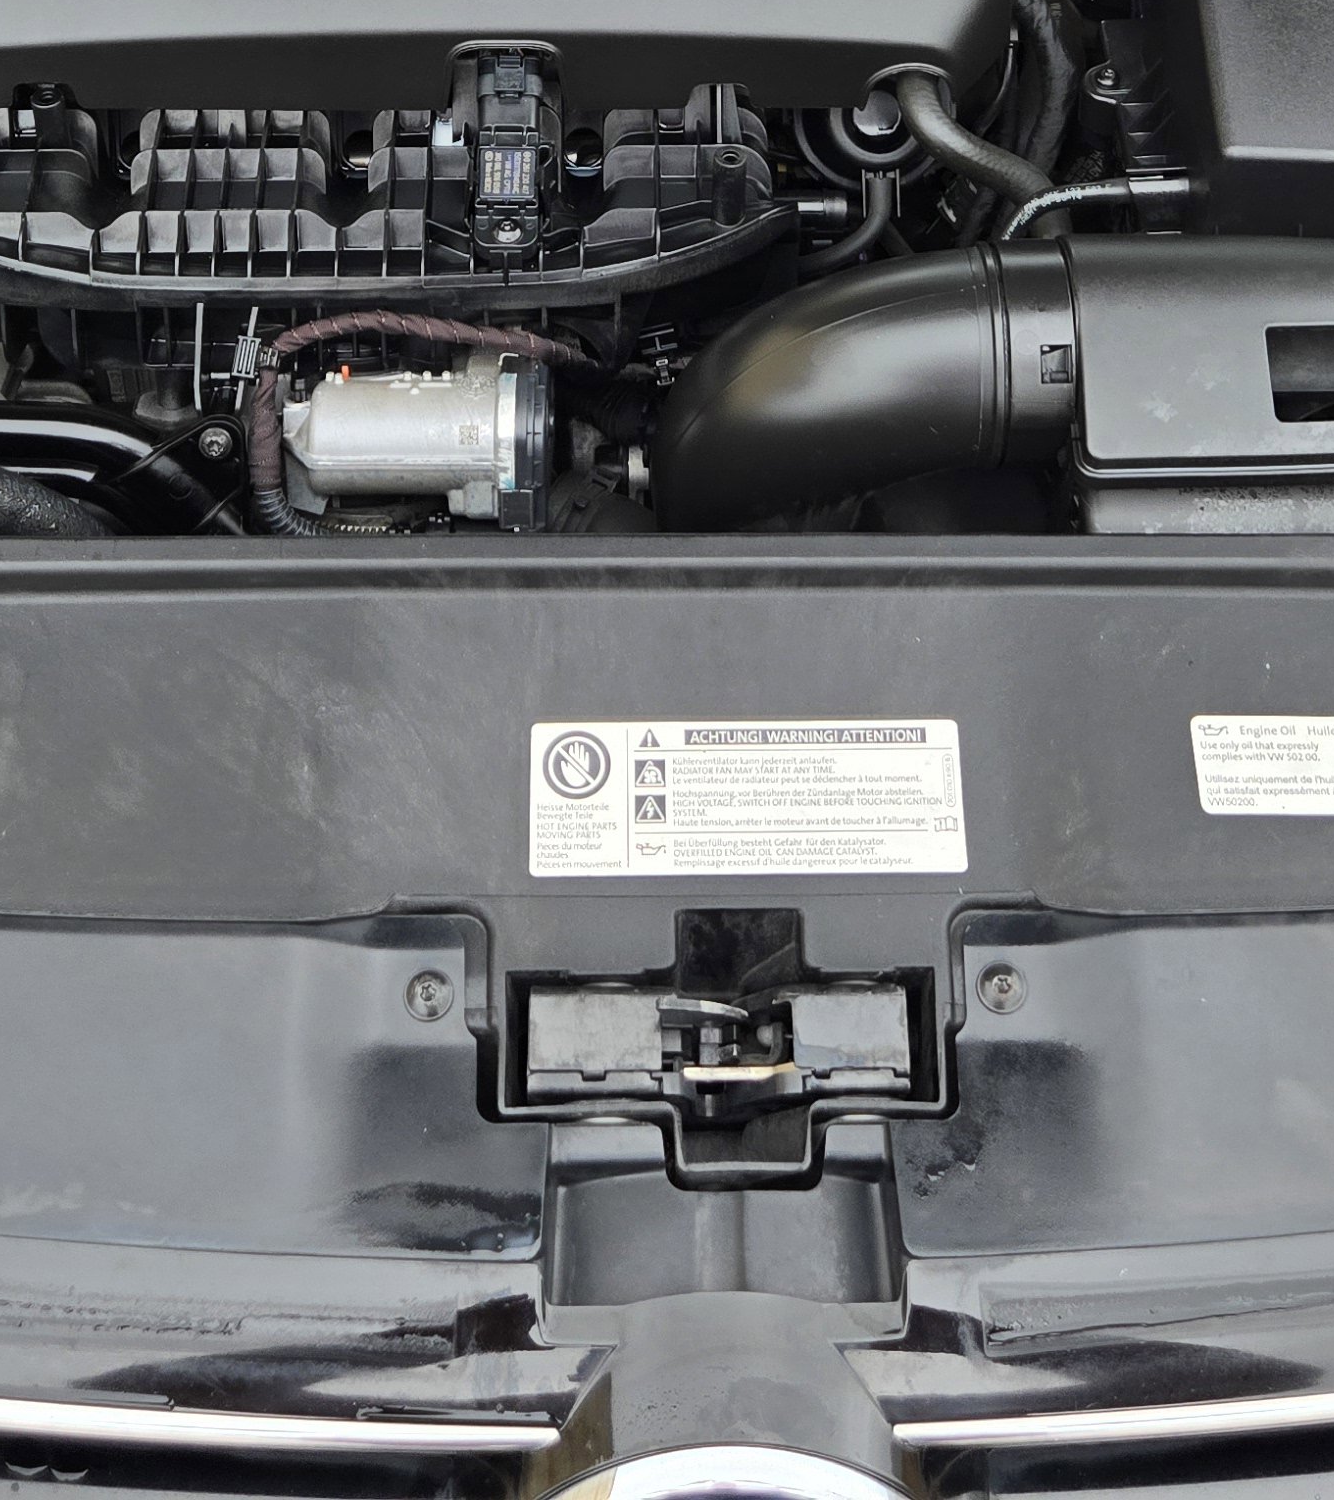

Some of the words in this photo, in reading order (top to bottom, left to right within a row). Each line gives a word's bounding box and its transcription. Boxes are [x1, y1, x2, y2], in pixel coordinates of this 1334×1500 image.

[1239, 726, 1277, 738] Engine
[1280, 726, 1296, 735] Oil
[1200, 741, 1217, 749] Use
[1219, 742, 1239, 751] only
[1277, 742, 1319, 751] expressly
[1202, 752, 1243, 762] complies
[1287, 753, 1303, 761] 502
[781, 766, 792, 774] AT
[794, 766, 811, 774] ANY
[781, 776, 800, 784] peut
[792, 788, 805, 796] der
[738, 798, 771, 806] SWITCH
[773, 798, 788, 806] OFF
[790, 798, 821, 806] ENGINE
[824, 798, 854, 806] BEFORE
[857, 798, 902, 806] TOUCHING
[904, 797, 943, 805] IGNITION
[673, 818, 699, 826] Haute
[765, 817, 772, 826] le
[773, 818, 804, 826] moteur
[831, 817, 841, 825] de
[843, 816, 875, 825] toucher
[741, 838, 771, 846] besteht
[820, 838, 835, 846] den
[838, 837, 887, 846] Katalysator.
[776, 848, 794, 856] CAN
